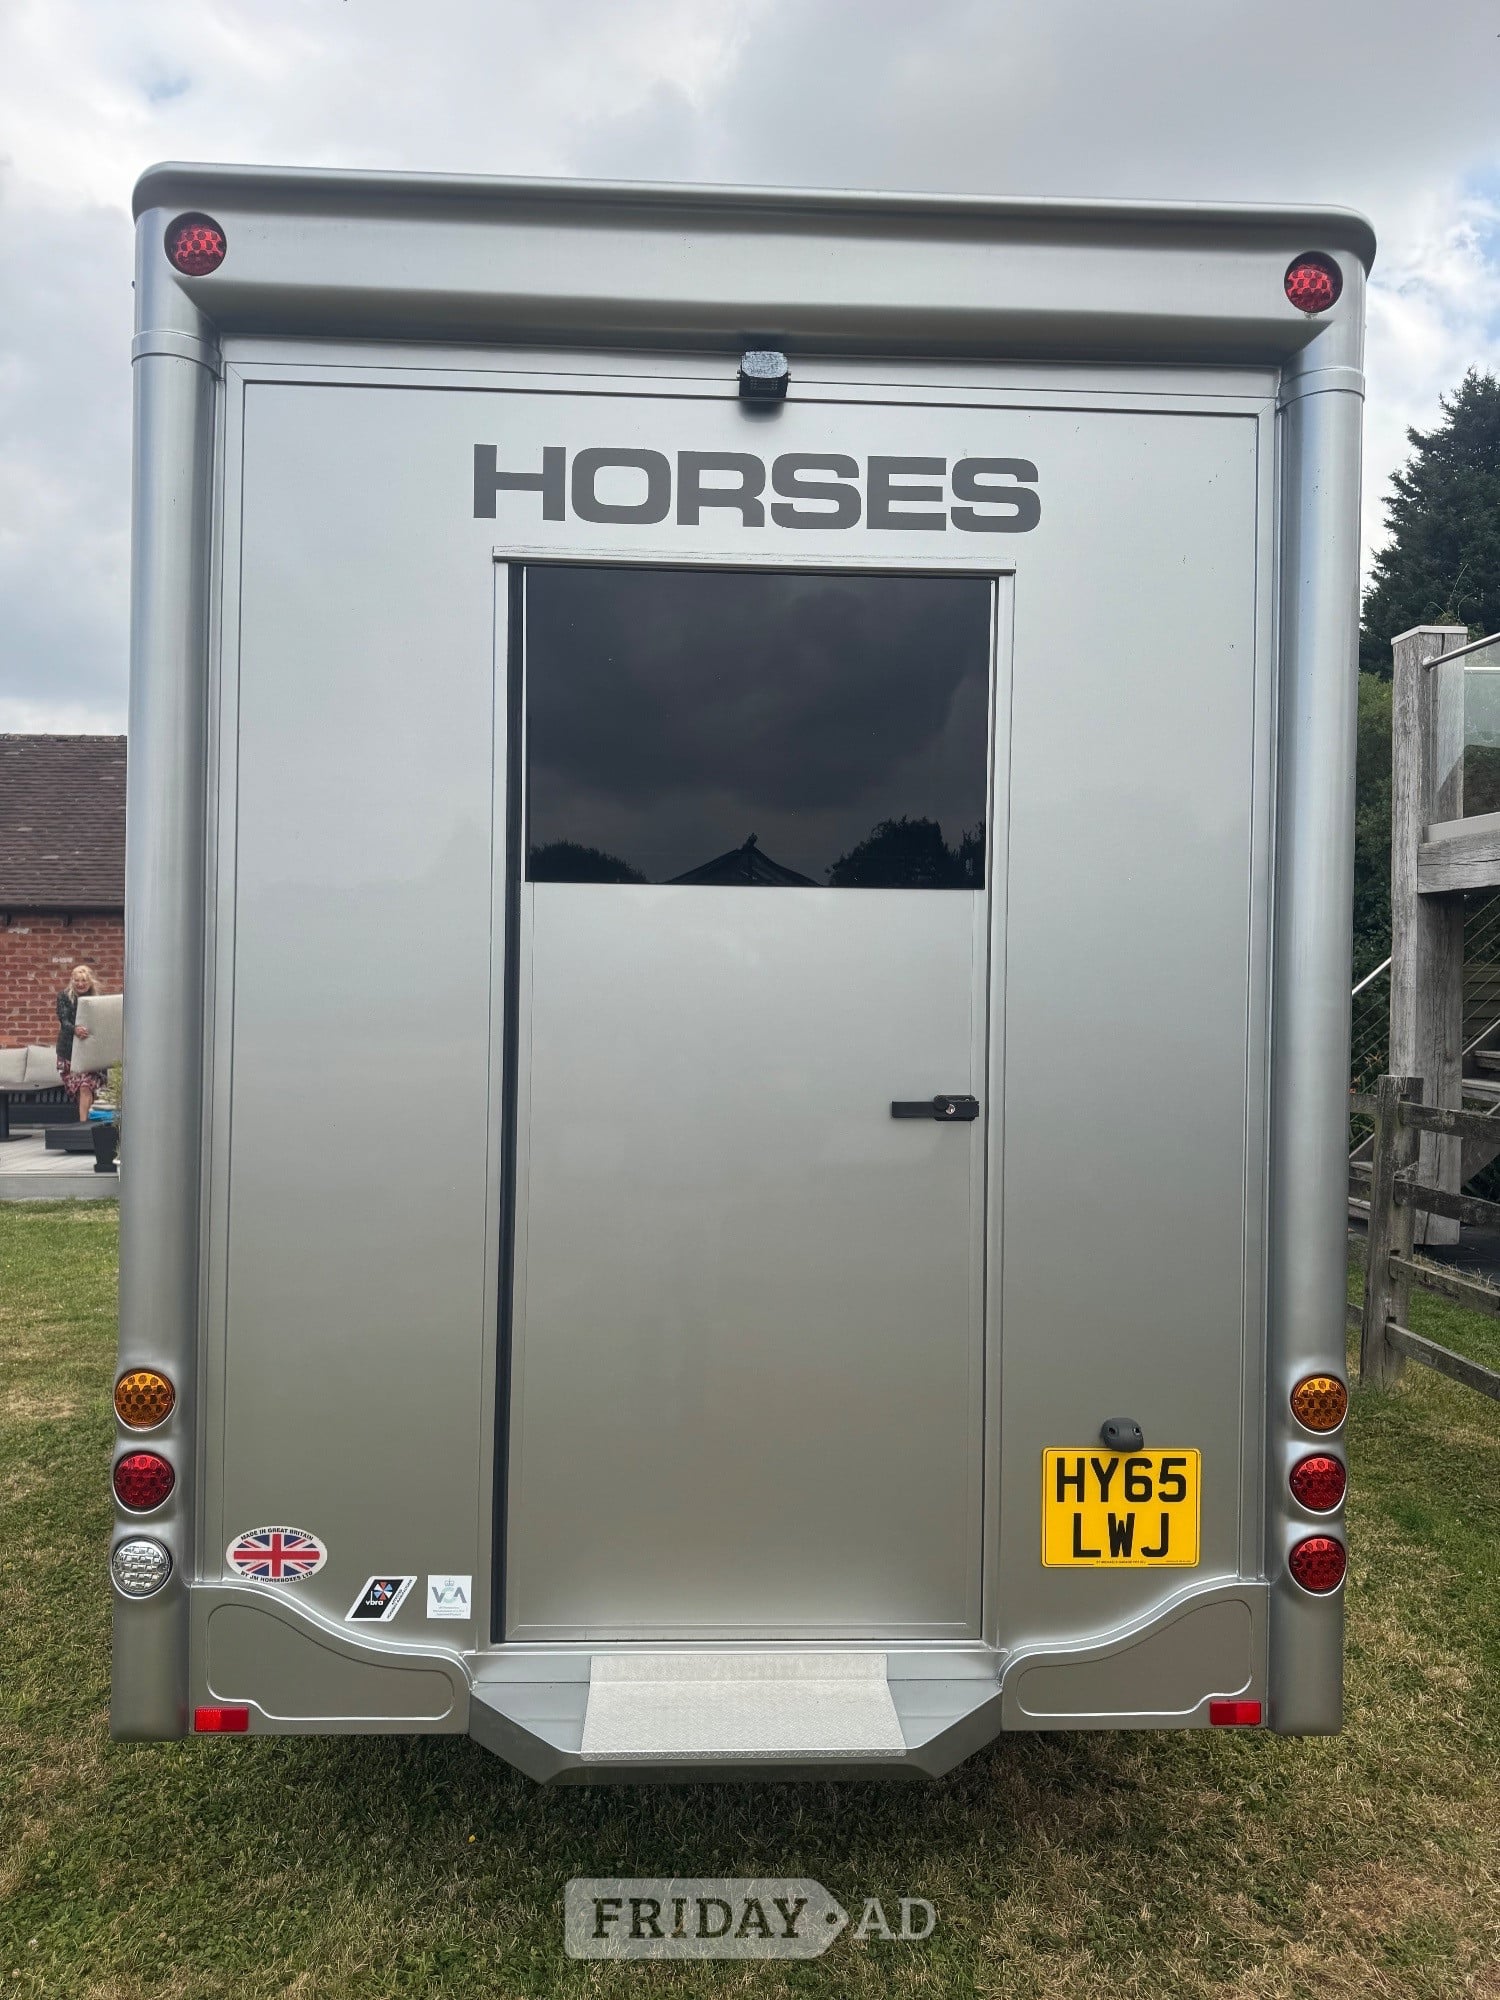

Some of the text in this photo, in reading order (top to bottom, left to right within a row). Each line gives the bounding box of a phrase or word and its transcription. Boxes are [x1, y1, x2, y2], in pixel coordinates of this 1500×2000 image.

[473, 443, 1041, 534] HORSES
[1056, 1457, 1187, 1503] HY65
[240, 1531, 258, 1541] MADE
[289, 1528, 314, 1541] BRITAIN
[1072, 1512, 1169, 1558] LWJ
[260, 1575, 302, 1583] HORSEBOXES
[302, 1570, 313, 1579] LTD
[431, 1586, 468, 1604] VCA
